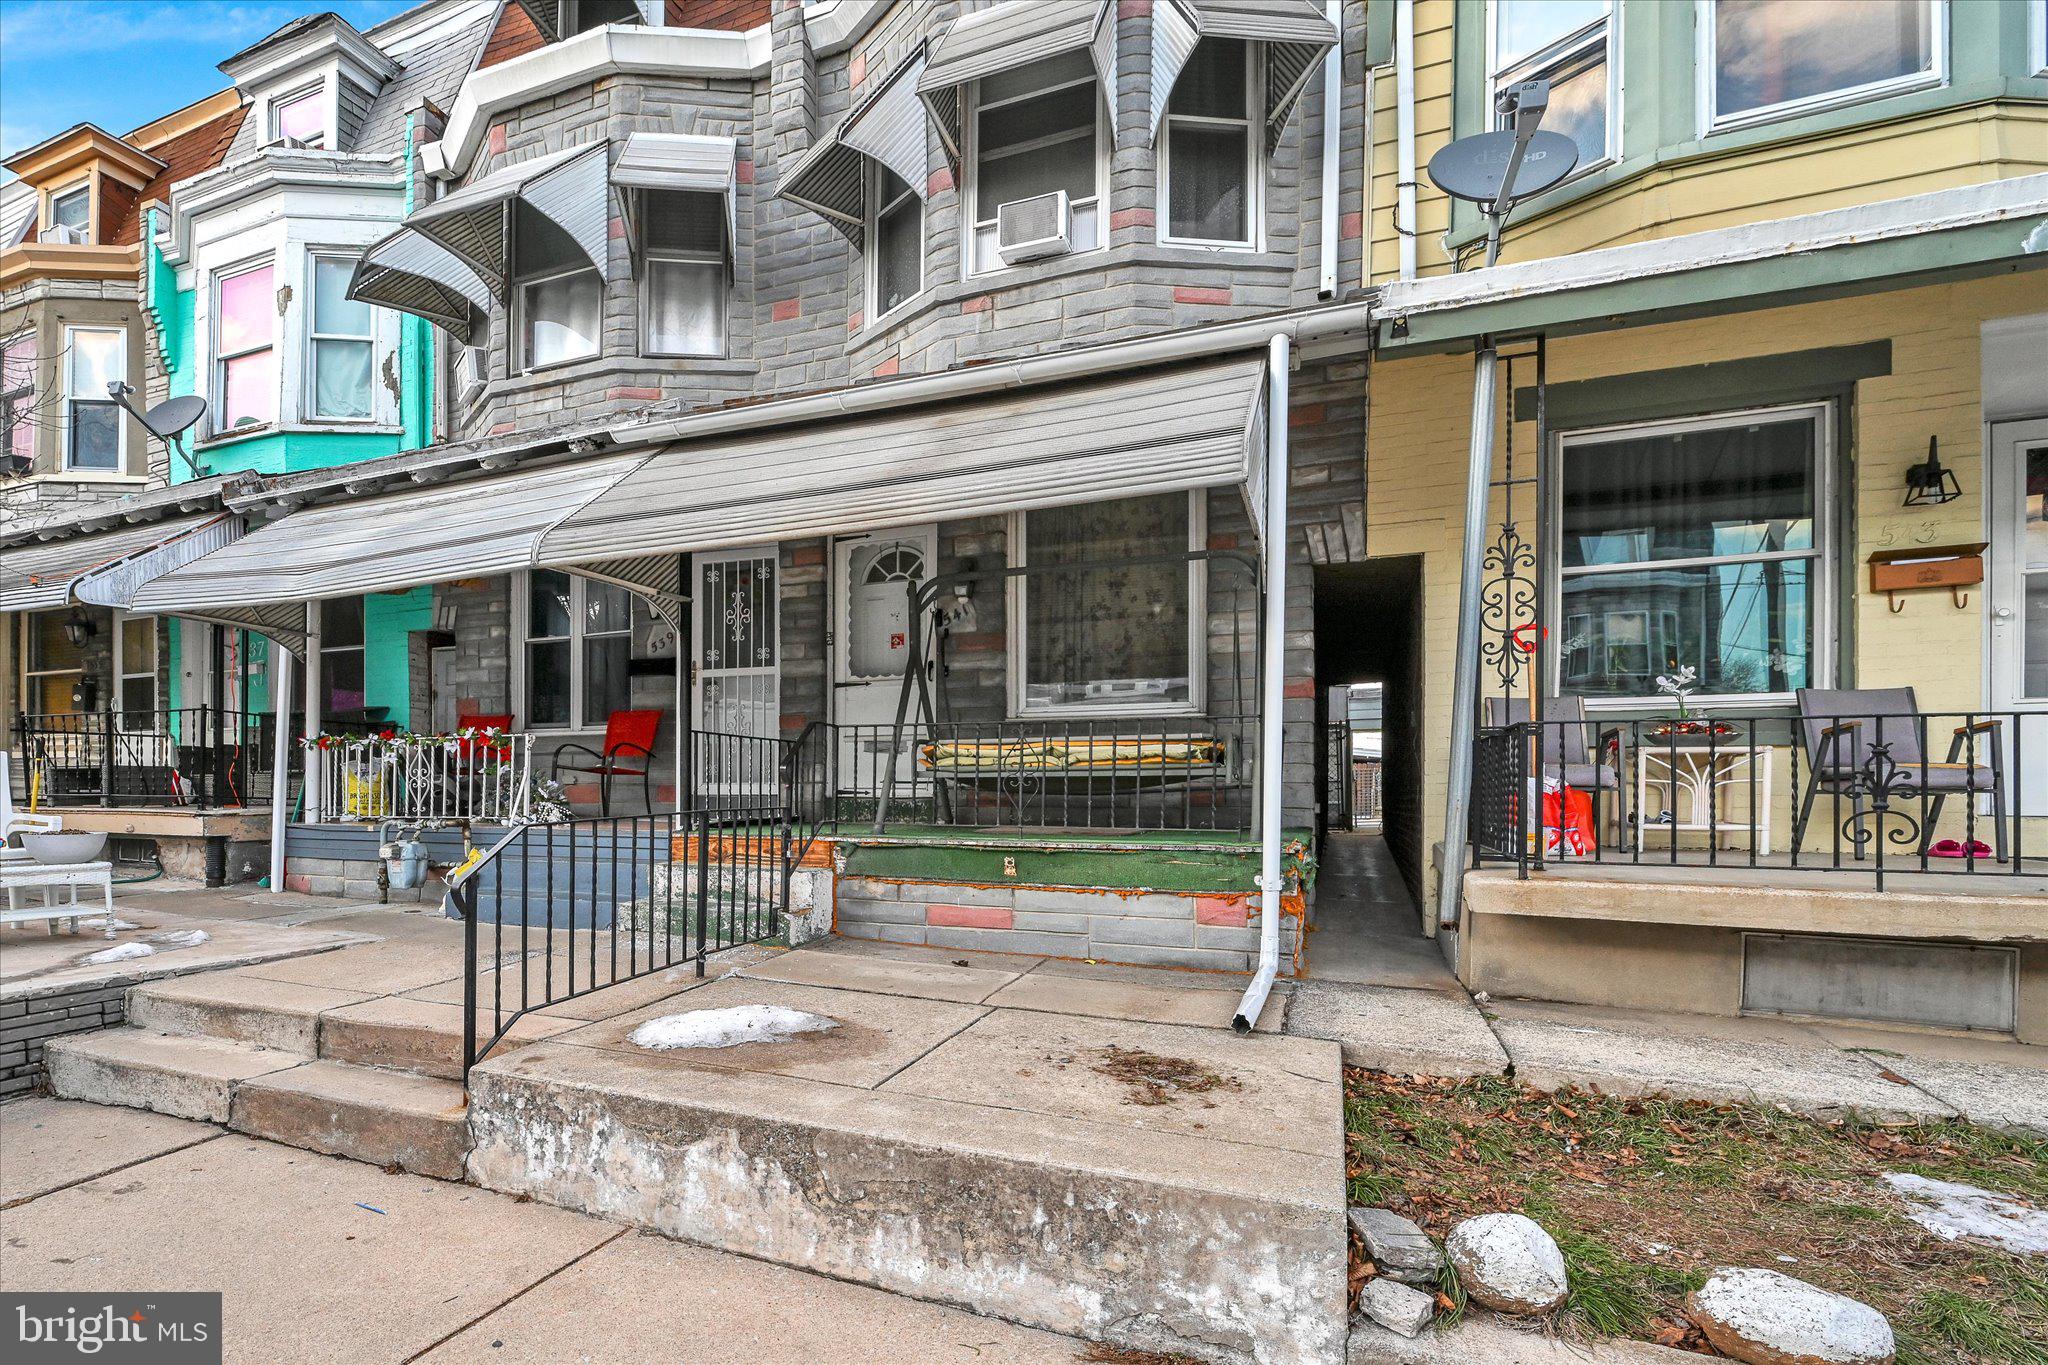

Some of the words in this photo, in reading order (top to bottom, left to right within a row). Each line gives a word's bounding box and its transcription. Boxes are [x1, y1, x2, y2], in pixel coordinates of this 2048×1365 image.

[1524, 151, 1547, 163] HD
[249, 641, 265, 657] 37
[651, 632, 674, 653] 539
